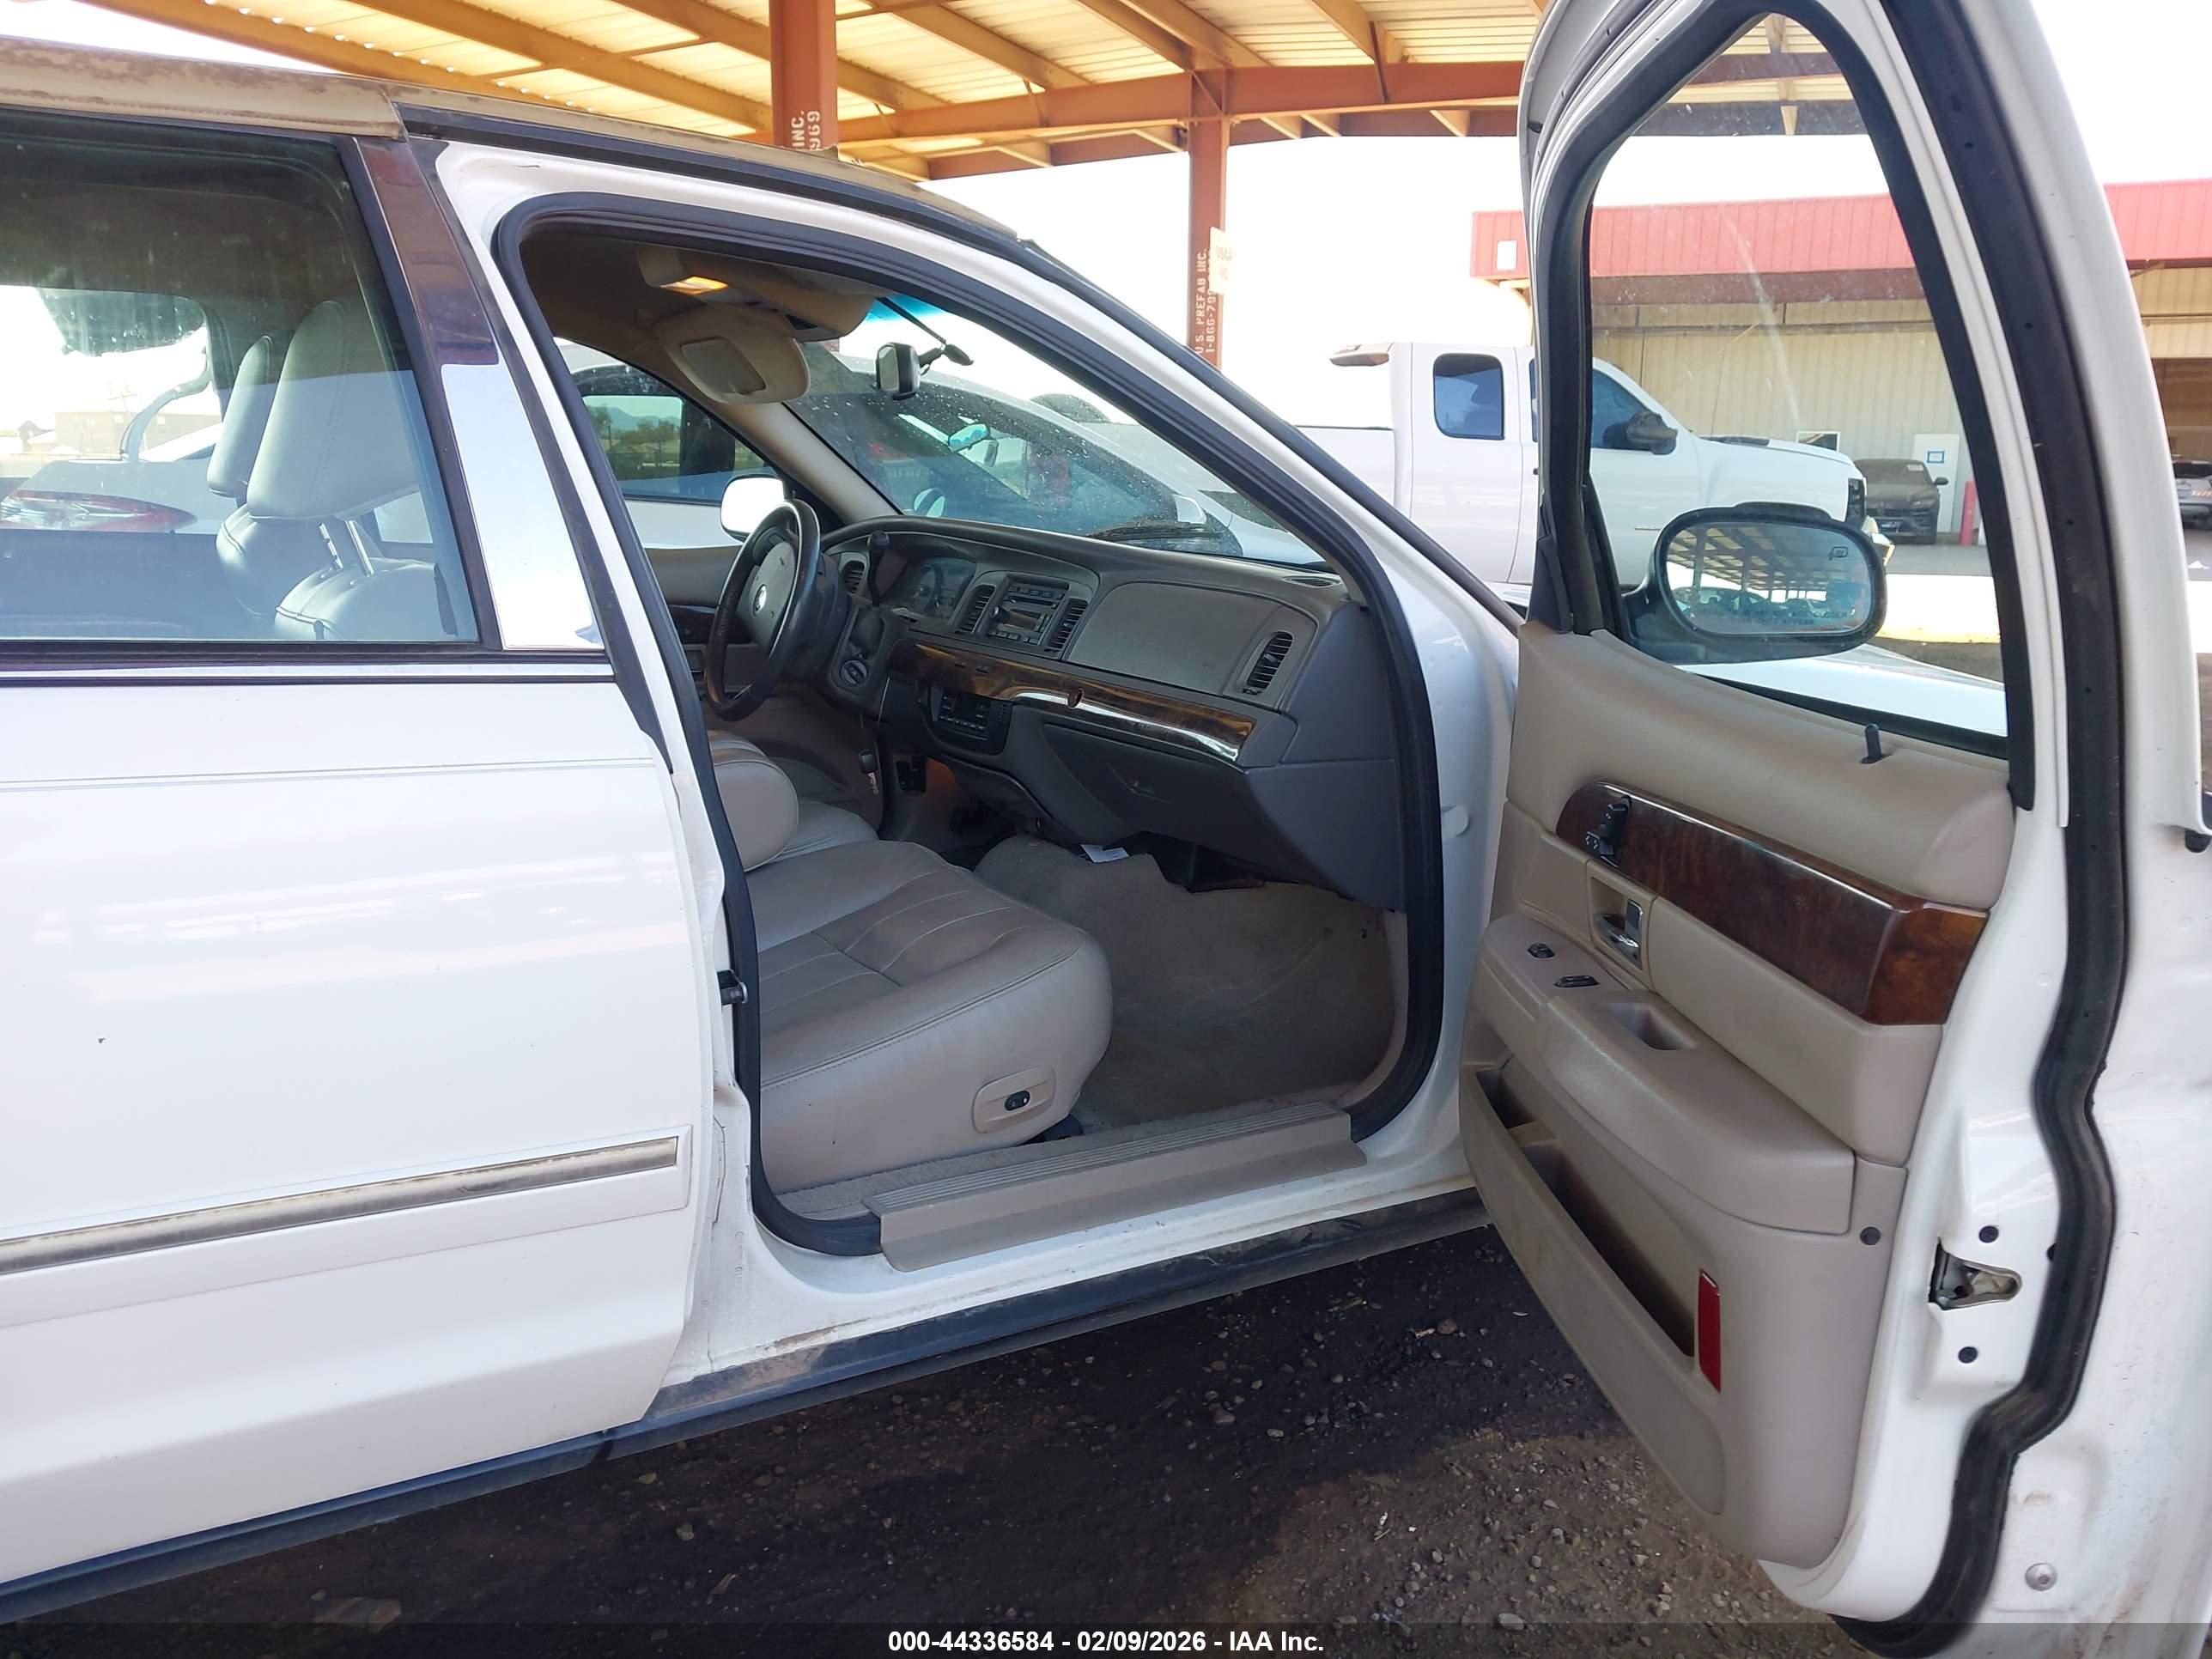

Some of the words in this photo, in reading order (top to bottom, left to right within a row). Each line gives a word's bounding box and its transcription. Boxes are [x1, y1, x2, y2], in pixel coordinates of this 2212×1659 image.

[791, 111, 805, 147] INC.
[1197, 248, 1207, 272] INC.
[1196, 278, 1206, 325] PREFAB
